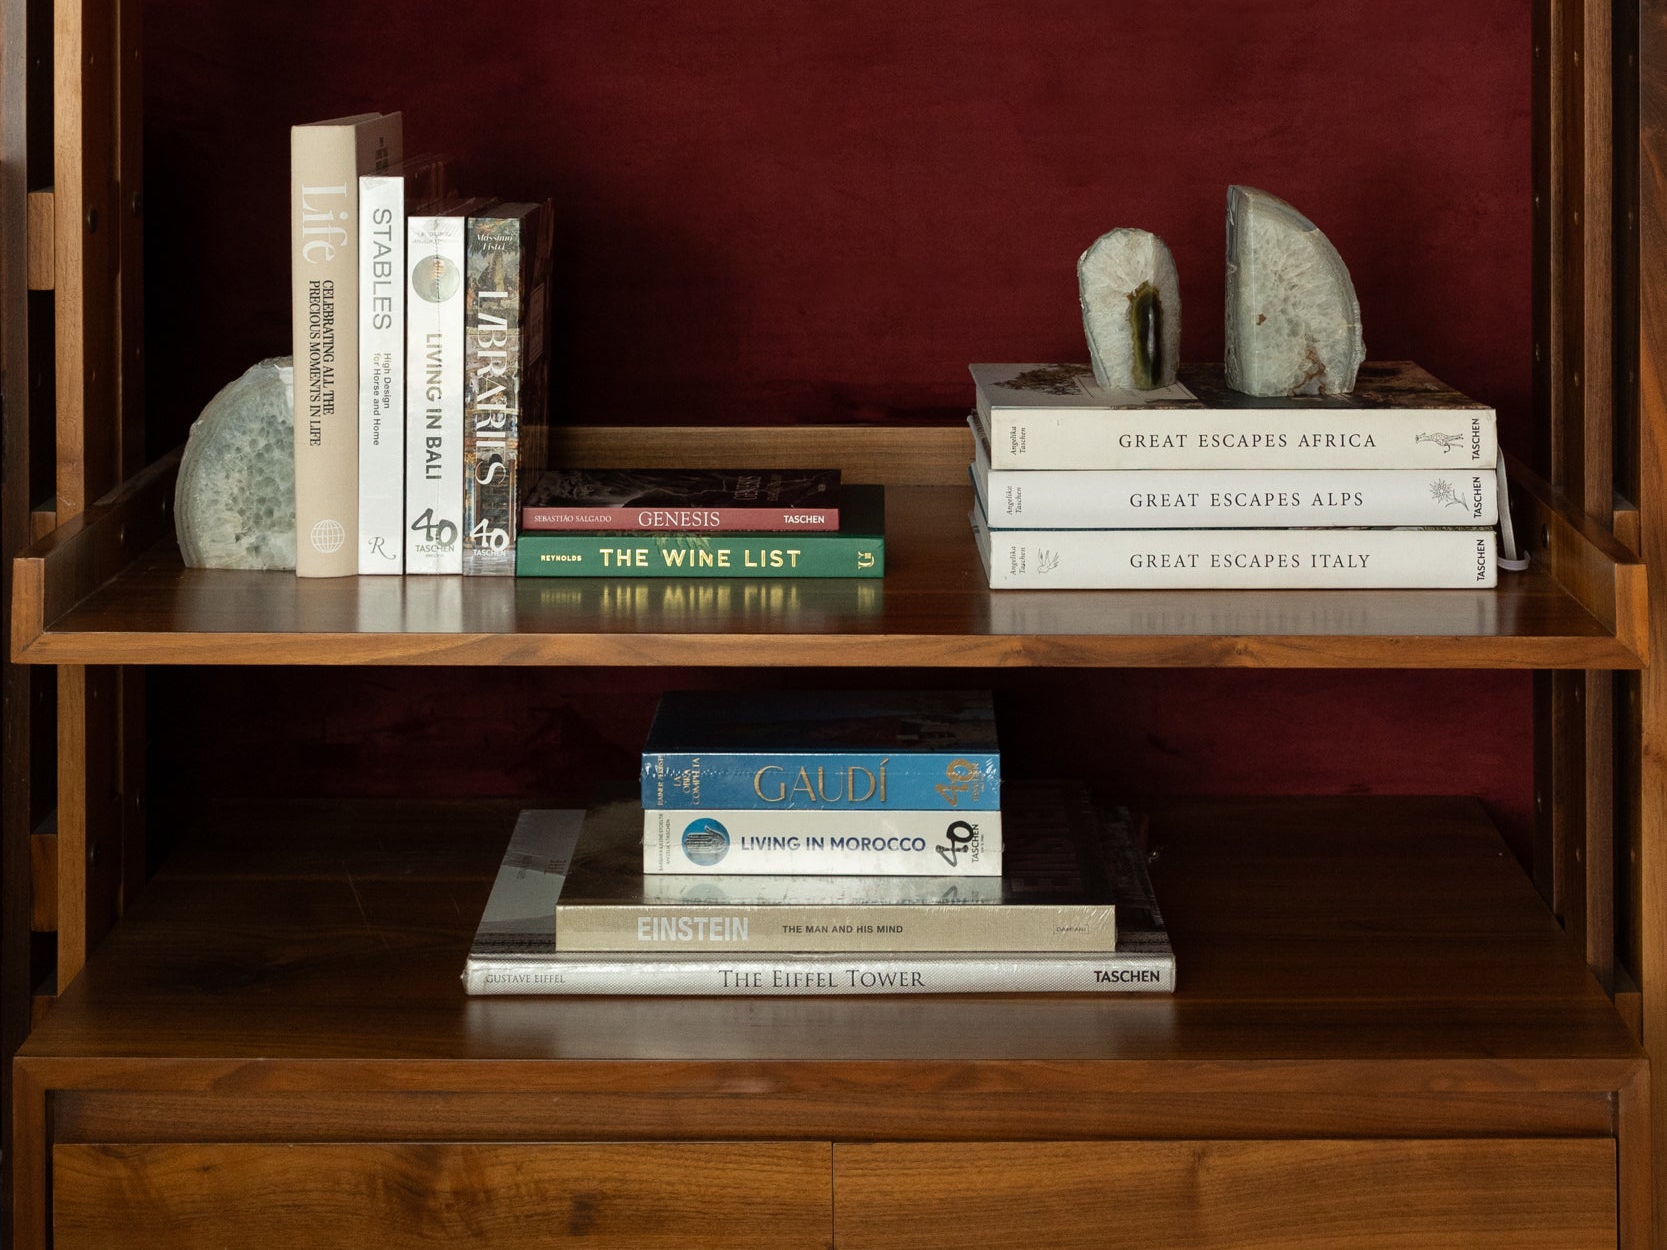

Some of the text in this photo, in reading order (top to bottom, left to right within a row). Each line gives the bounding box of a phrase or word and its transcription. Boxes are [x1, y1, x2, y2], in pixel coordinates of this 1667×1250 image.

[301, 182, 348, 264] Life
[372, 208, 392, 330] STABLES
[309, 280, 321, 447] PRECIOUS MOMENTS IN LIFE
[322, 279, 335, 416] CELEBRATING ALL THE
[382, 353, 392, 409] High Design
[474, 291, 509, 485] LIBRARIES
[373, 353, 381, 446] for Horse and Home
[425, 333, 442, 480] LIVING IN BALI
[1118, 433, 1377, 449] GREAT ESCAPES AFRICA
[1472, 418, 1481, 461] TASCHEN
[1129, 491, 1365, 508] GREAT ESCAPES ALPS
[1472, 476, 1482, 519] TASCHEN
[411, 507, 459, 547] 40
[469, 518, 510, 551] 40
[575, 515, 612, 523] SALGADO
[638, 510, 721, 528] GENESIS
[783, 515, 825, 524] TASCHEN
[415, 544, 455, 553] TASCHEN
[472, 550, 506, 558] TASCHEN
[540, 554, 583, 562] REYNOLDS
[599, 549, 802, 568] THE WINE LIST
[1129, 553, 1372, 569] GREAT ESCAPES ITALY
[1476, 539, 1486, 582] TASCHEN
[682, 768, 692, 794] OBRA
[692, 757, 701, 806] COMPLETA
[753, 757, 890, 803] GAUDÍ
[935, 757, 974, 807] 40
[741, 836, 926, 852] LIVING IN MOROCCO
[935, 820, 975, 868] 40
[971, 823, 980, 863] TASCHEN
[636, 916, 749, 942] EINSTEIN
[782, 925, 904, 934] THE MAN AND HIS MIND
[485, 974, 566, 984] GUSTAVE EIFFEL
[1093, 970, 1161, 983] TASCHEN
